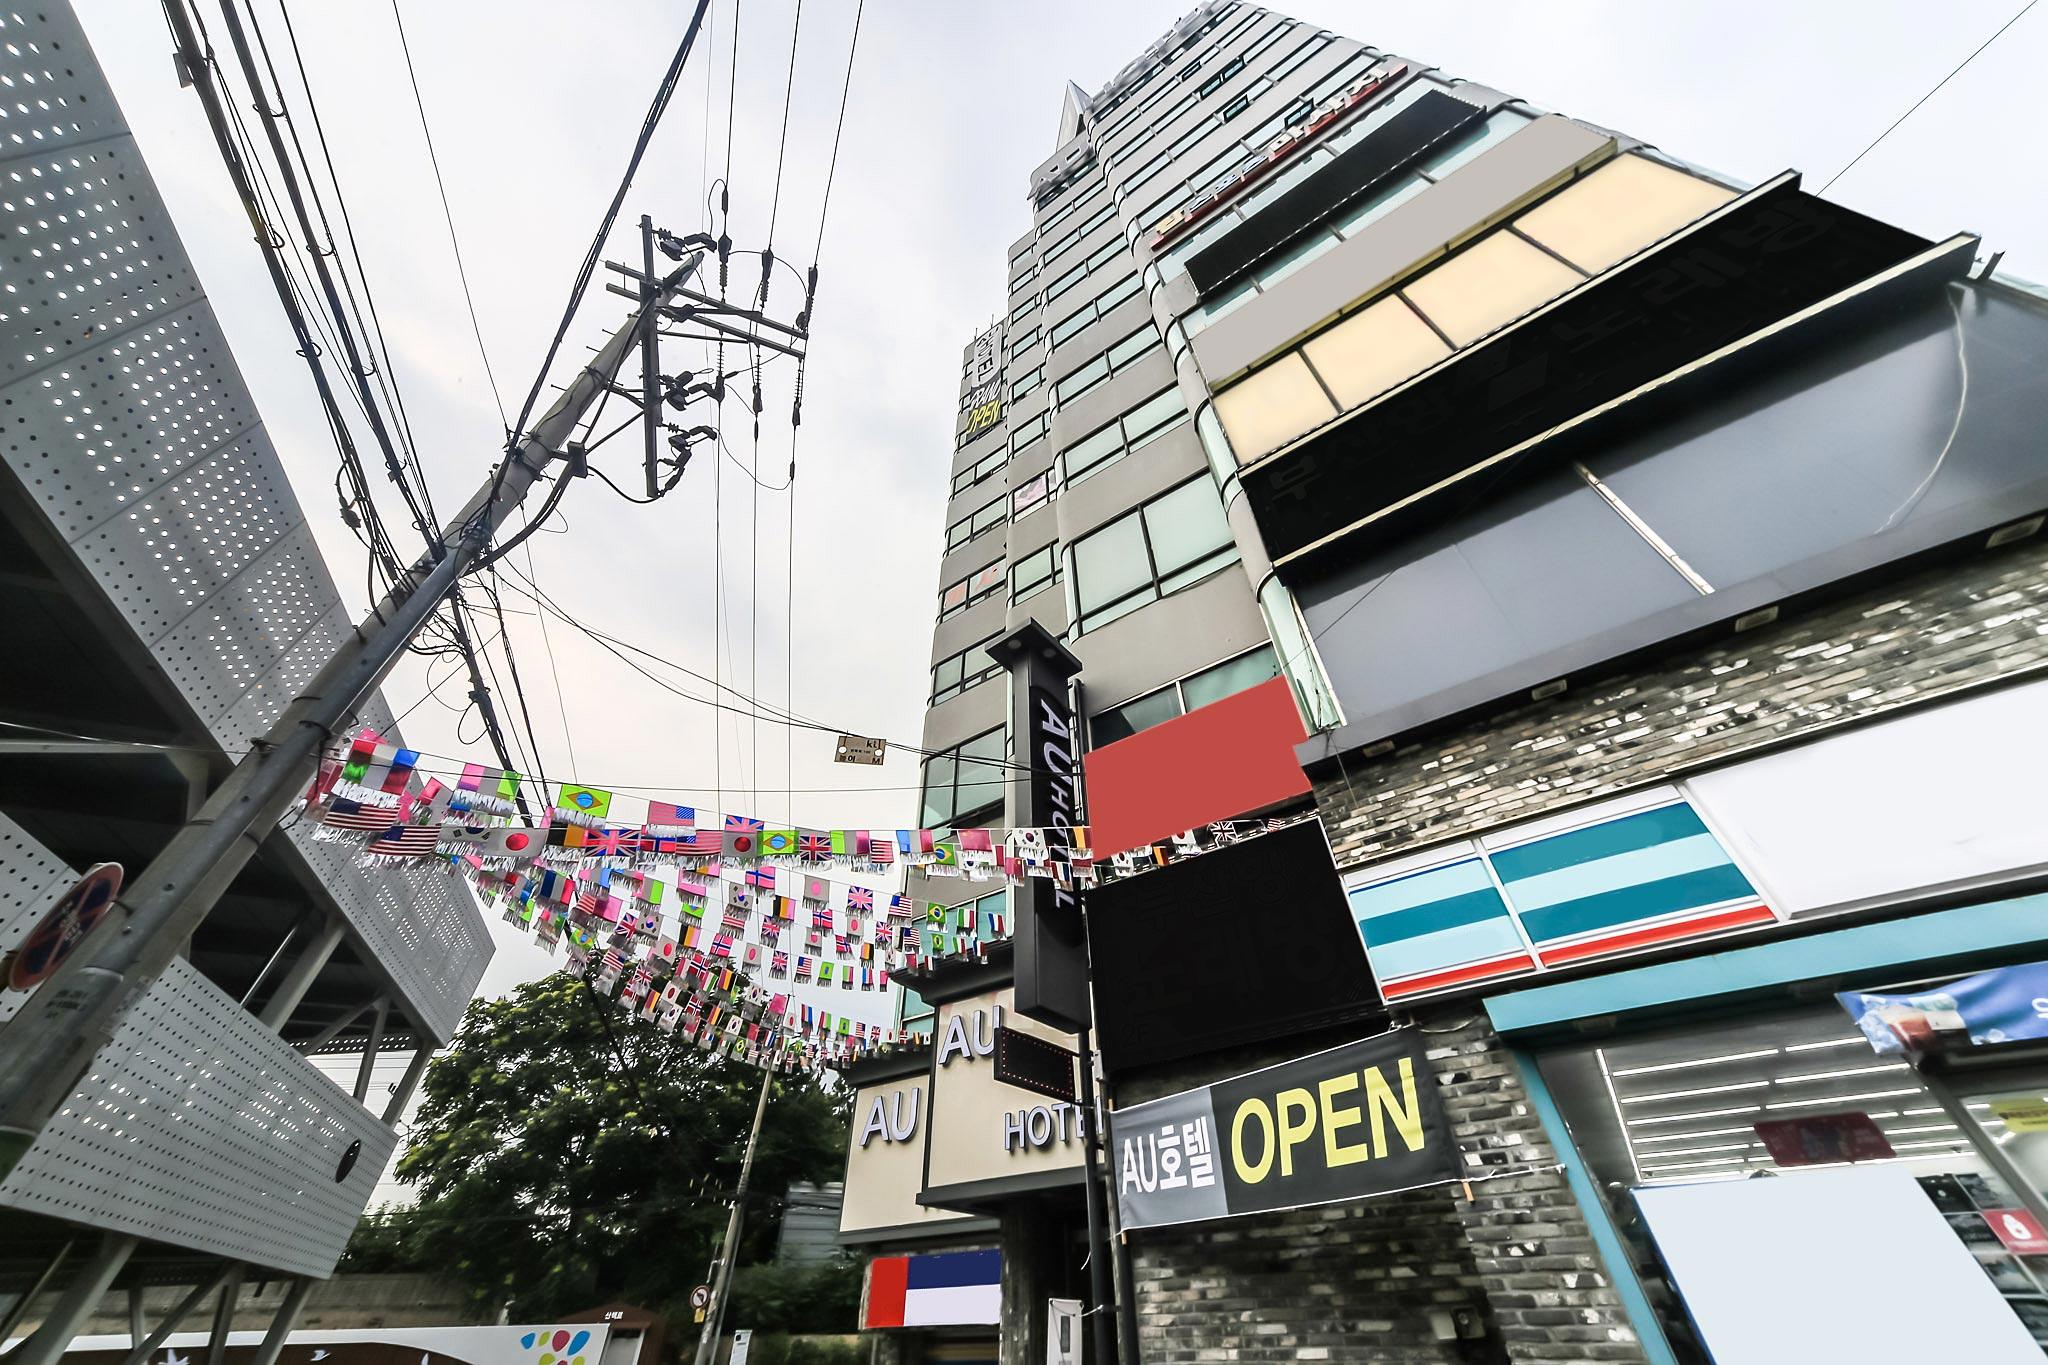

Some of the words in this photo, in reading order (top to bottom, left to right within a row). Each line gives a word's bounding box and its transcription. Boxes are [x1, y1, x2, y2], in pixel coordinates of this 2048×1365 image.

[938, 1004, 1004, 1065] AU
[859, 1087, 921, 1147] AU
[1121, 1116, 1216, 1195] AU호텔
[1231, 1056, 1426, 1185] OPEN
